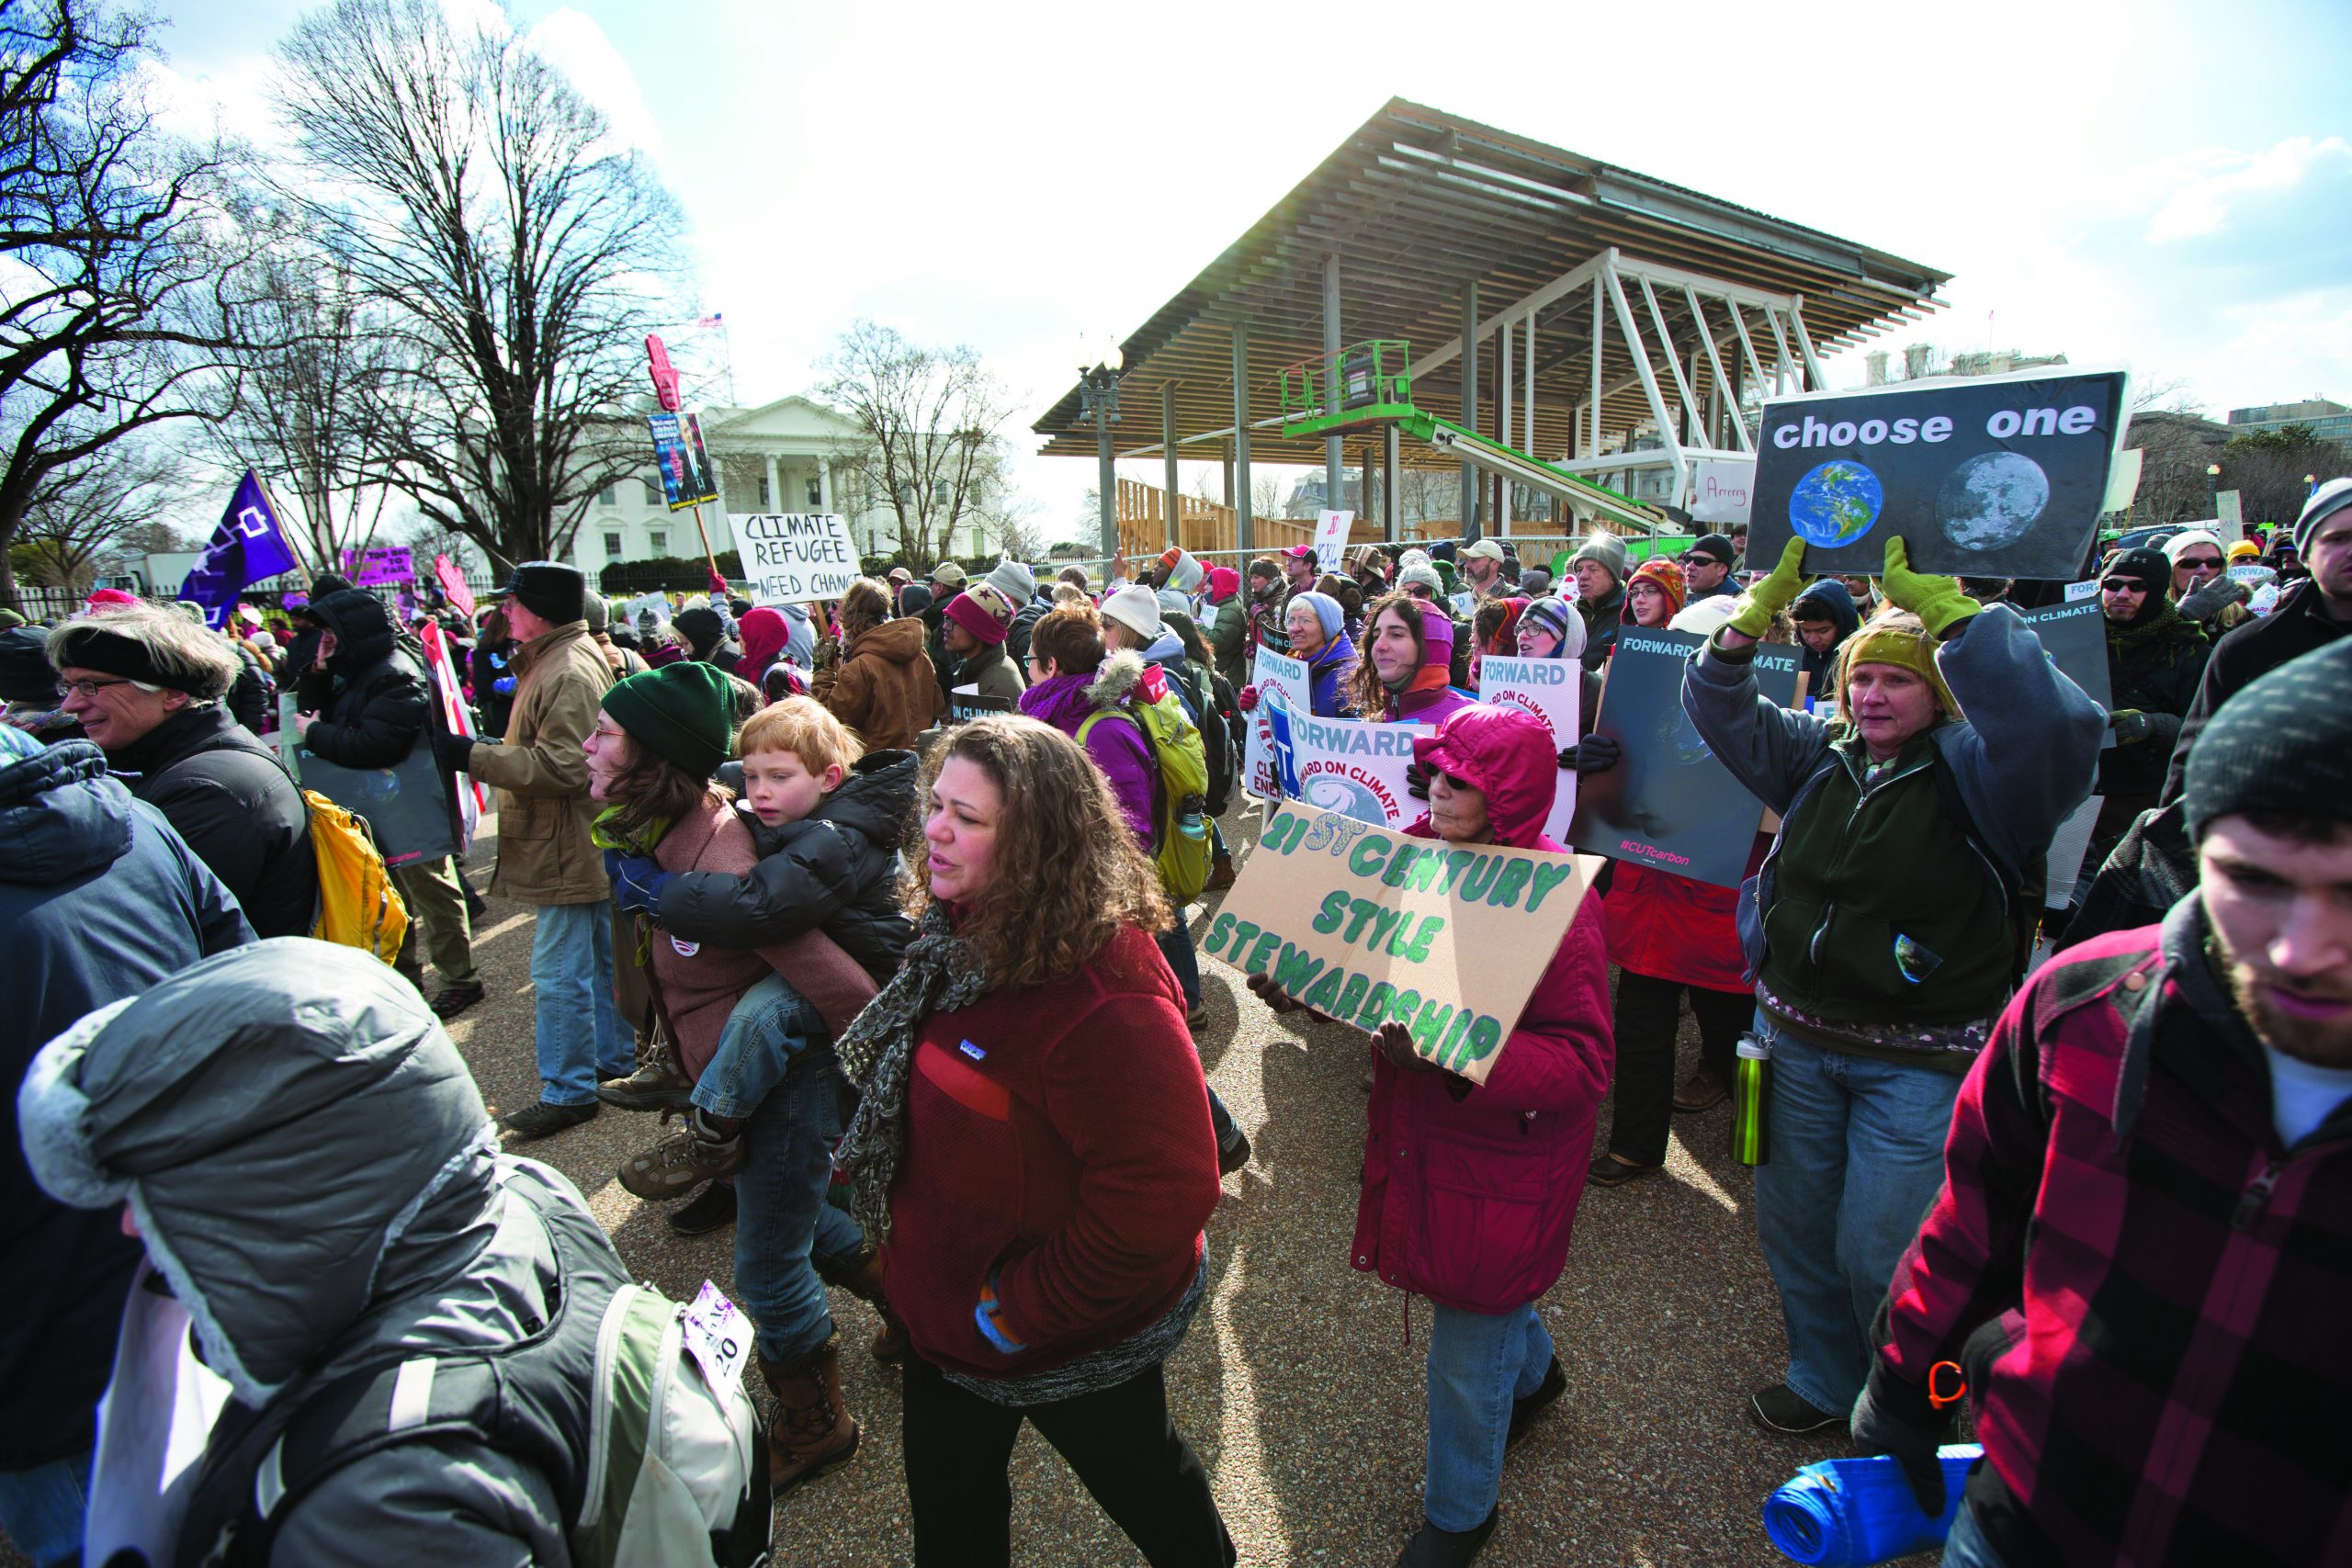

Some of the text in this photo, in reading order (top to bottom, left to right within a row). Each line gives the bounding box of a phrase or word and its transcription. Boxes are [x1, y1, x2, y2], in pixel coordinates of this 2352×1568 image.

[1773, 405, 2096, 449] choose one
[745, 514, 842, 539] CLIMATE
[755, 540, 848, 567] REFUGEE
[760, 574, 802, 598] NEED
[2040, 604, 2098, 622] CLIMATE
[1258, 650, 1302, 681] FORWARD
[1623, 637, 1796, 672] FORWARD MATE
[1484, 660, 1566, 685] FORWARD
[1503, 690, 1515, 701] ON
[1291, 710, 1414, 757] FORWARD
[1325, 761, 1346, 775] ON
[1350, 767, 1400, 820] CLIMATE
[1620, 840, 1690, 866] #CUTcarbon
[1349, 835, 1571, 913] CENTURY
[1312, 890, 1444, 964] STYLE
[1204, 912, 1502, 1072] STEWARDSHIP
[715, 1337, 738, 1377] 20
